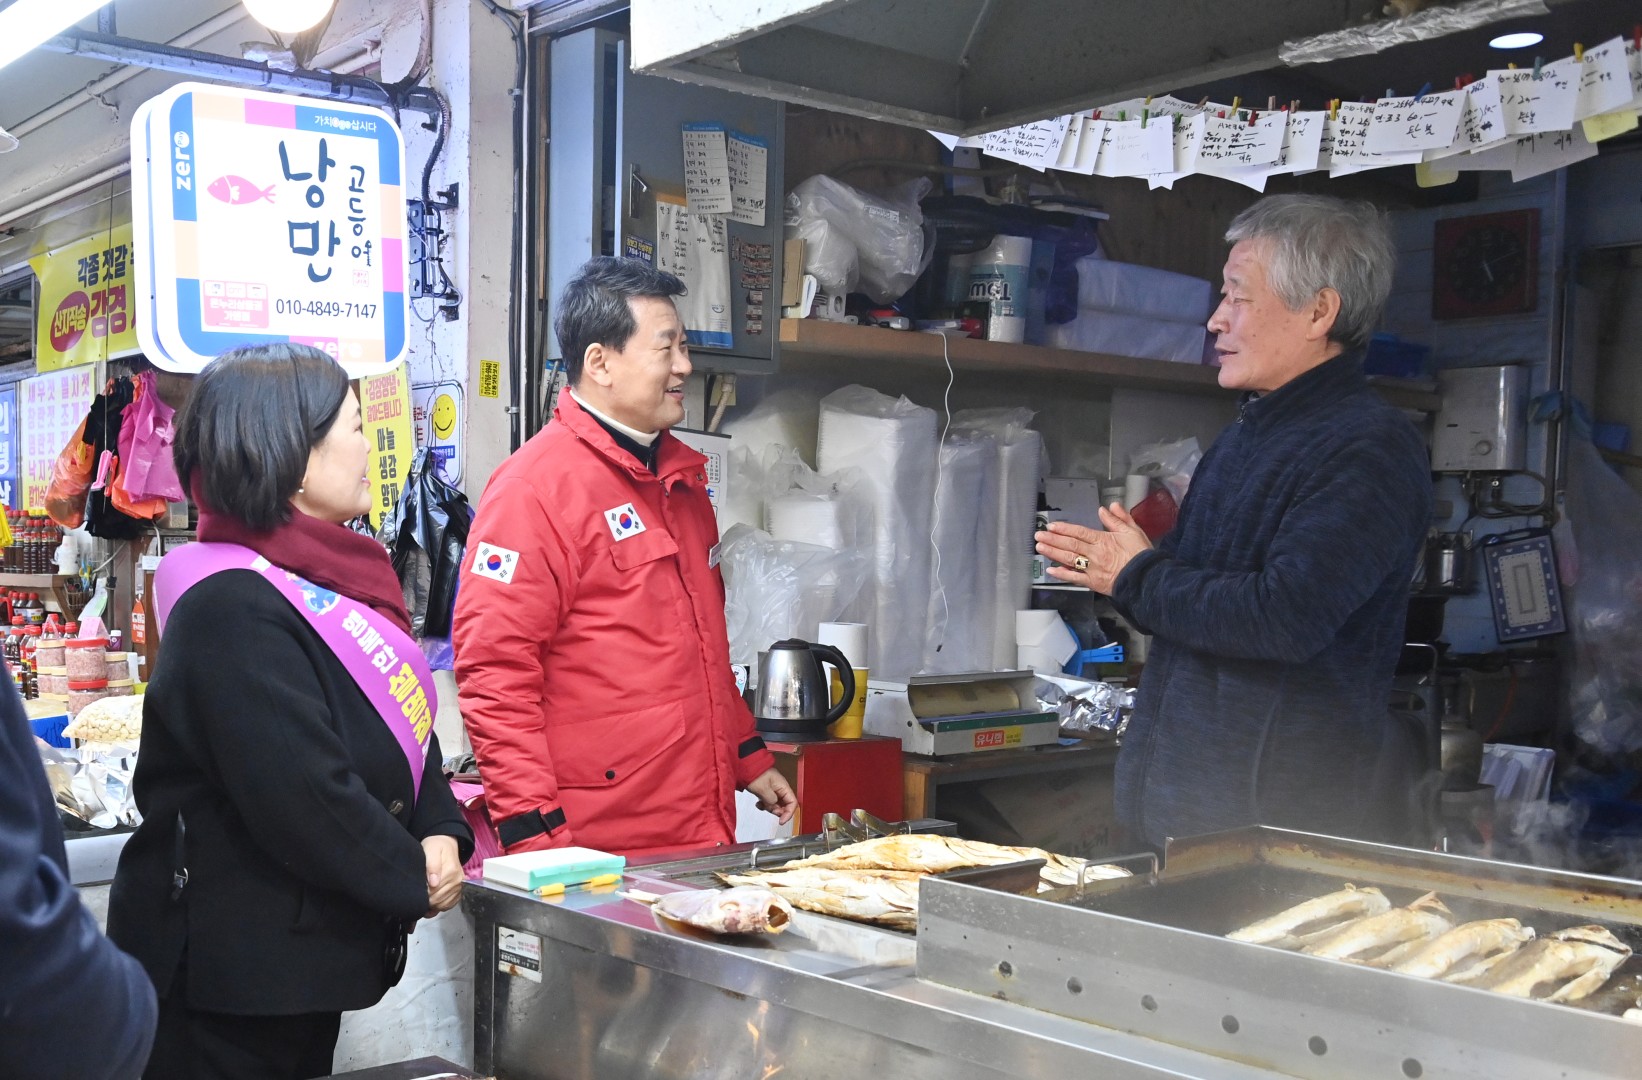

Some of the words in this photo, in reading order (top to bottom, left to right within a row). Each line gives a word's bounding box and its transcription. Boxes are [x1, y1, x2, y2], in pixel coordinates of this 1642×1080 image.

[173, 130, 191, 192] zero
[78, 252, 100, 289] 각종
[102, 243, 128, 282] 젓갈
[54, 302, 87, 338] 산지직송
[90, 284, 127, 339] 강경
[276, 298, 377, 319] 010-4849-7147
[28, 379, 55, 403] 새우젓
[368, 374, 397, 401] 김장양념
[366, 398, 402, 423] 갈아드립니다
[377, 427, 396, 452] 마늘
[379, 454, 396, 480] 생강
[381, 482, 399, 507] 양파
[342, 609, 399, 674] 행복한
[388, 662, 433, 745] 설명절
